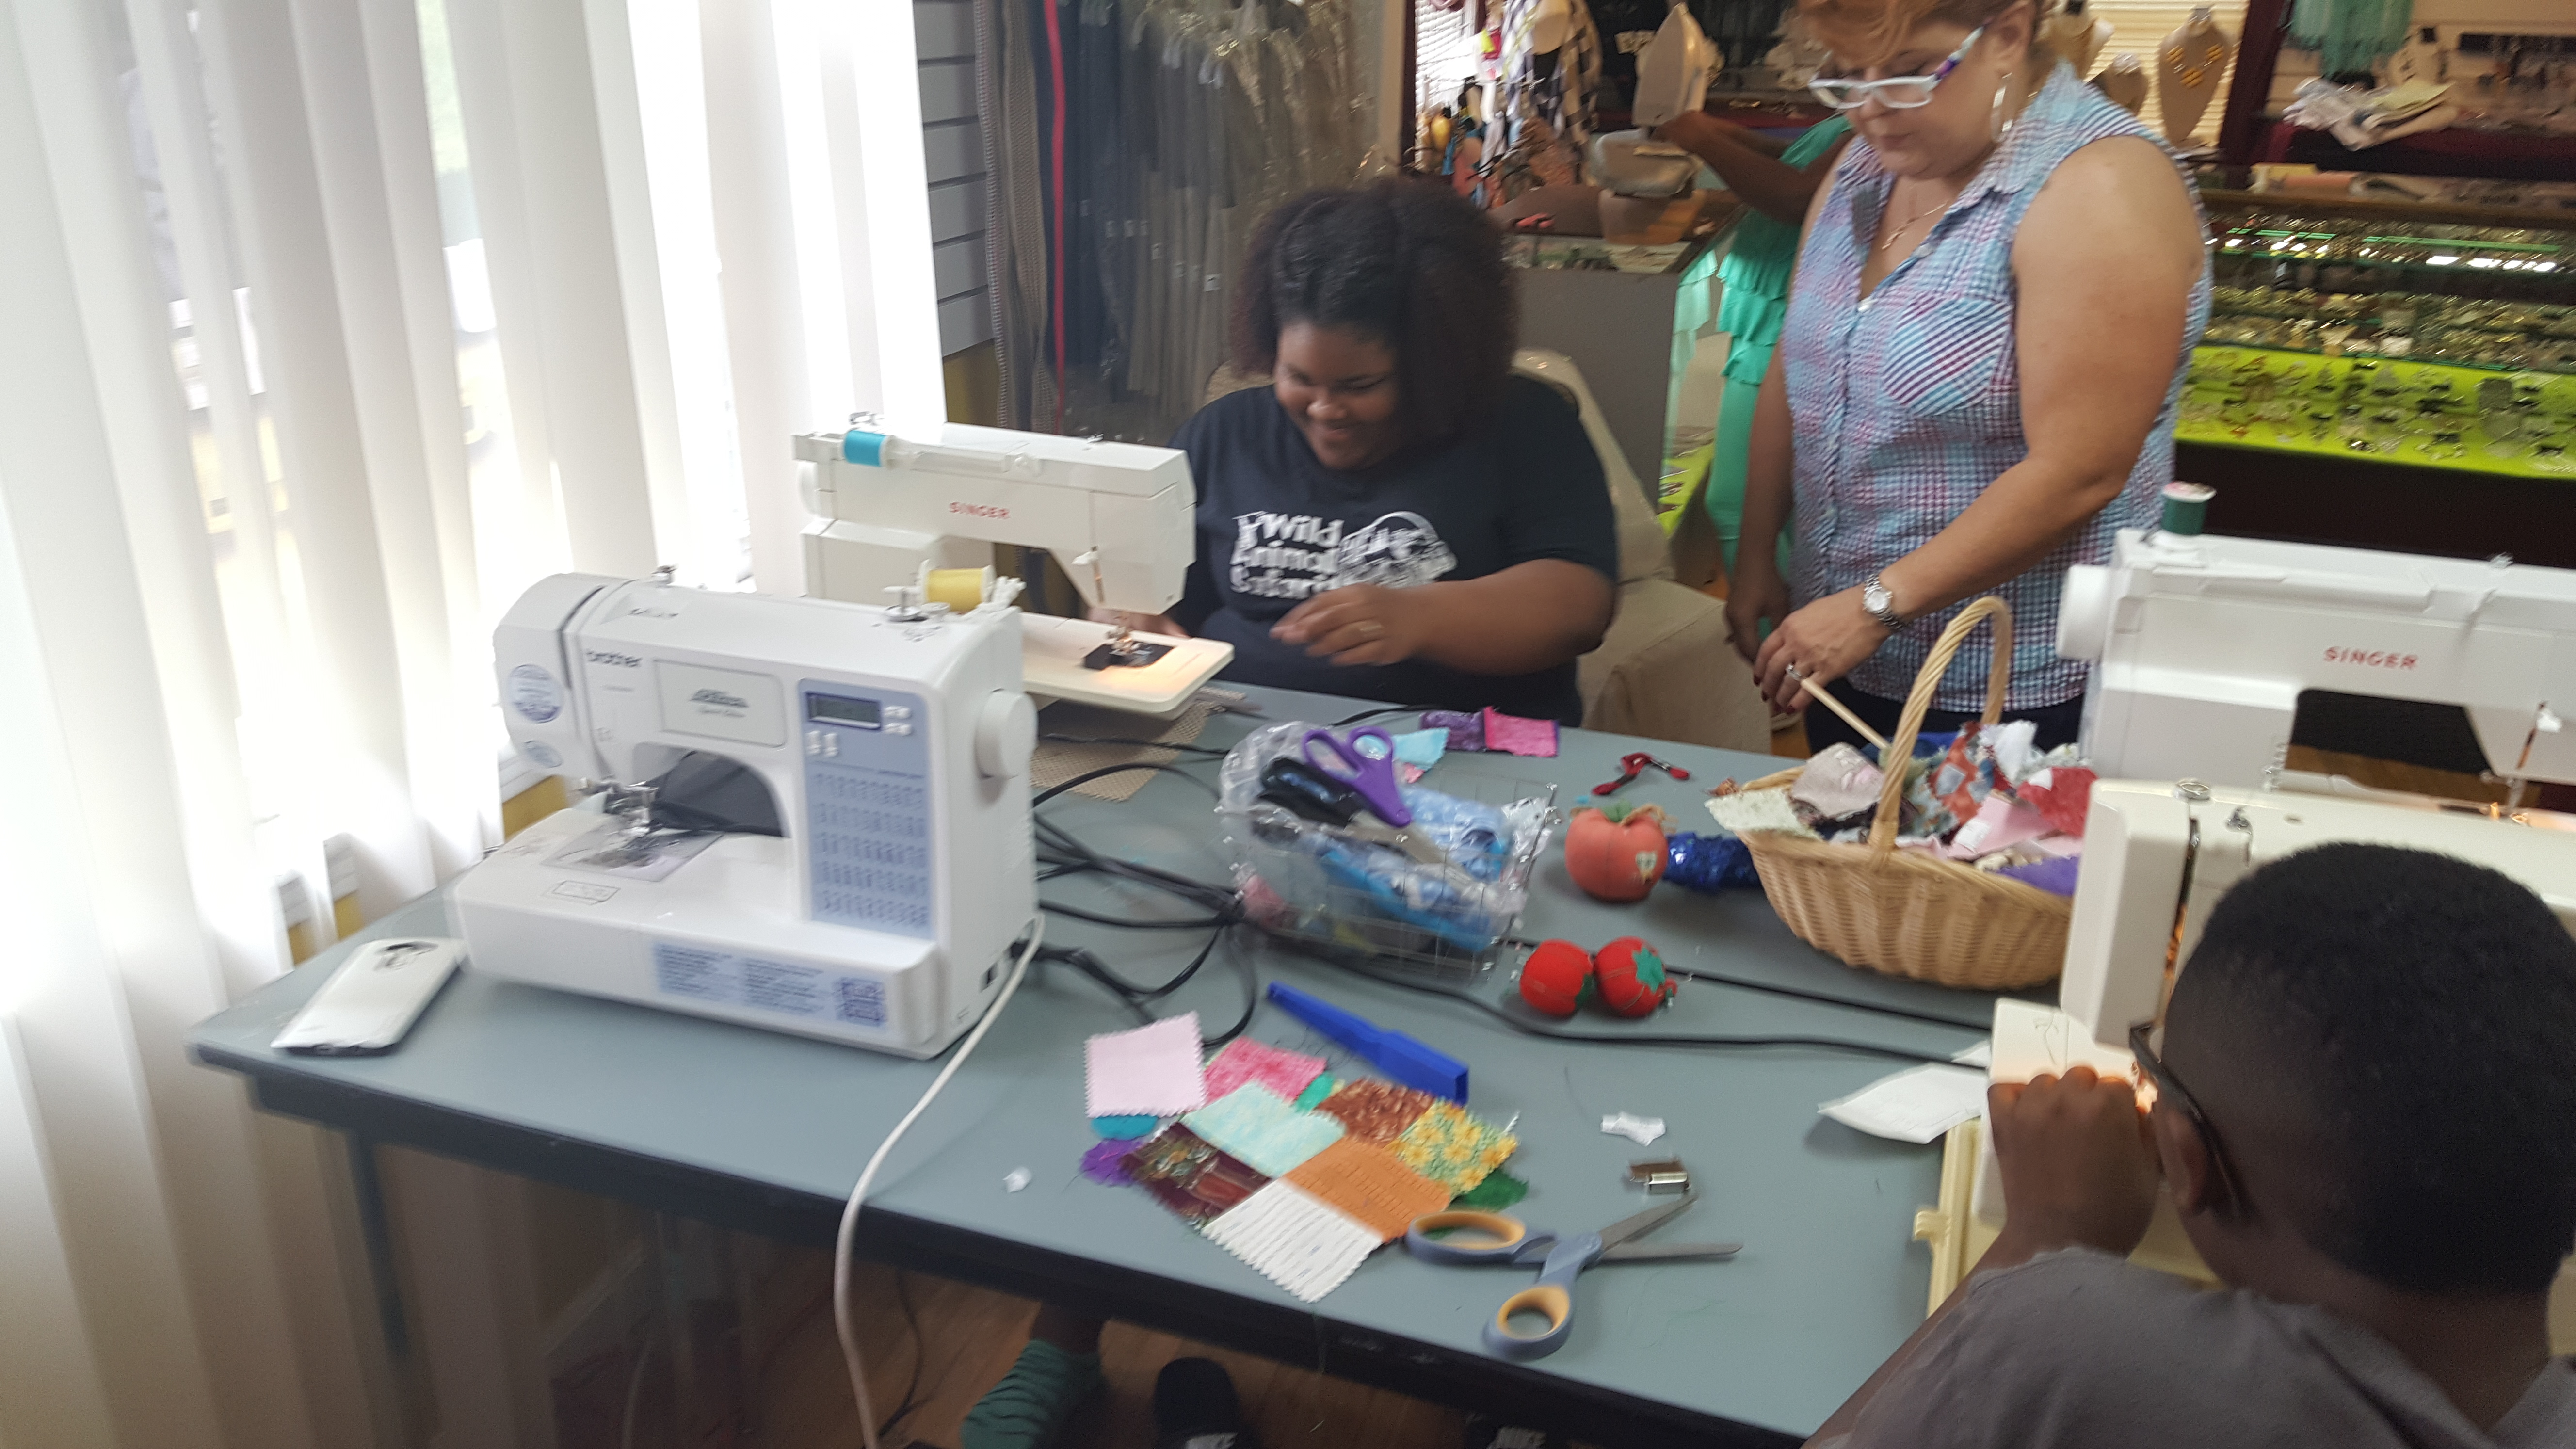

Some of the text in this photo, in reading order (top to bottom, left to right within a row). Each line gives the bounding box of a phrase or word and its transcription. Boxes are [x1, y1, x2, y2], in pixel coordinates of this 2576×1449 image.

[949, 501, 1010, 520] SINGER
[1258, 512, 1345, 548] Wild
[585, 648, 642, 668] brother
[2323, 646, 2418, 671] SINGER
